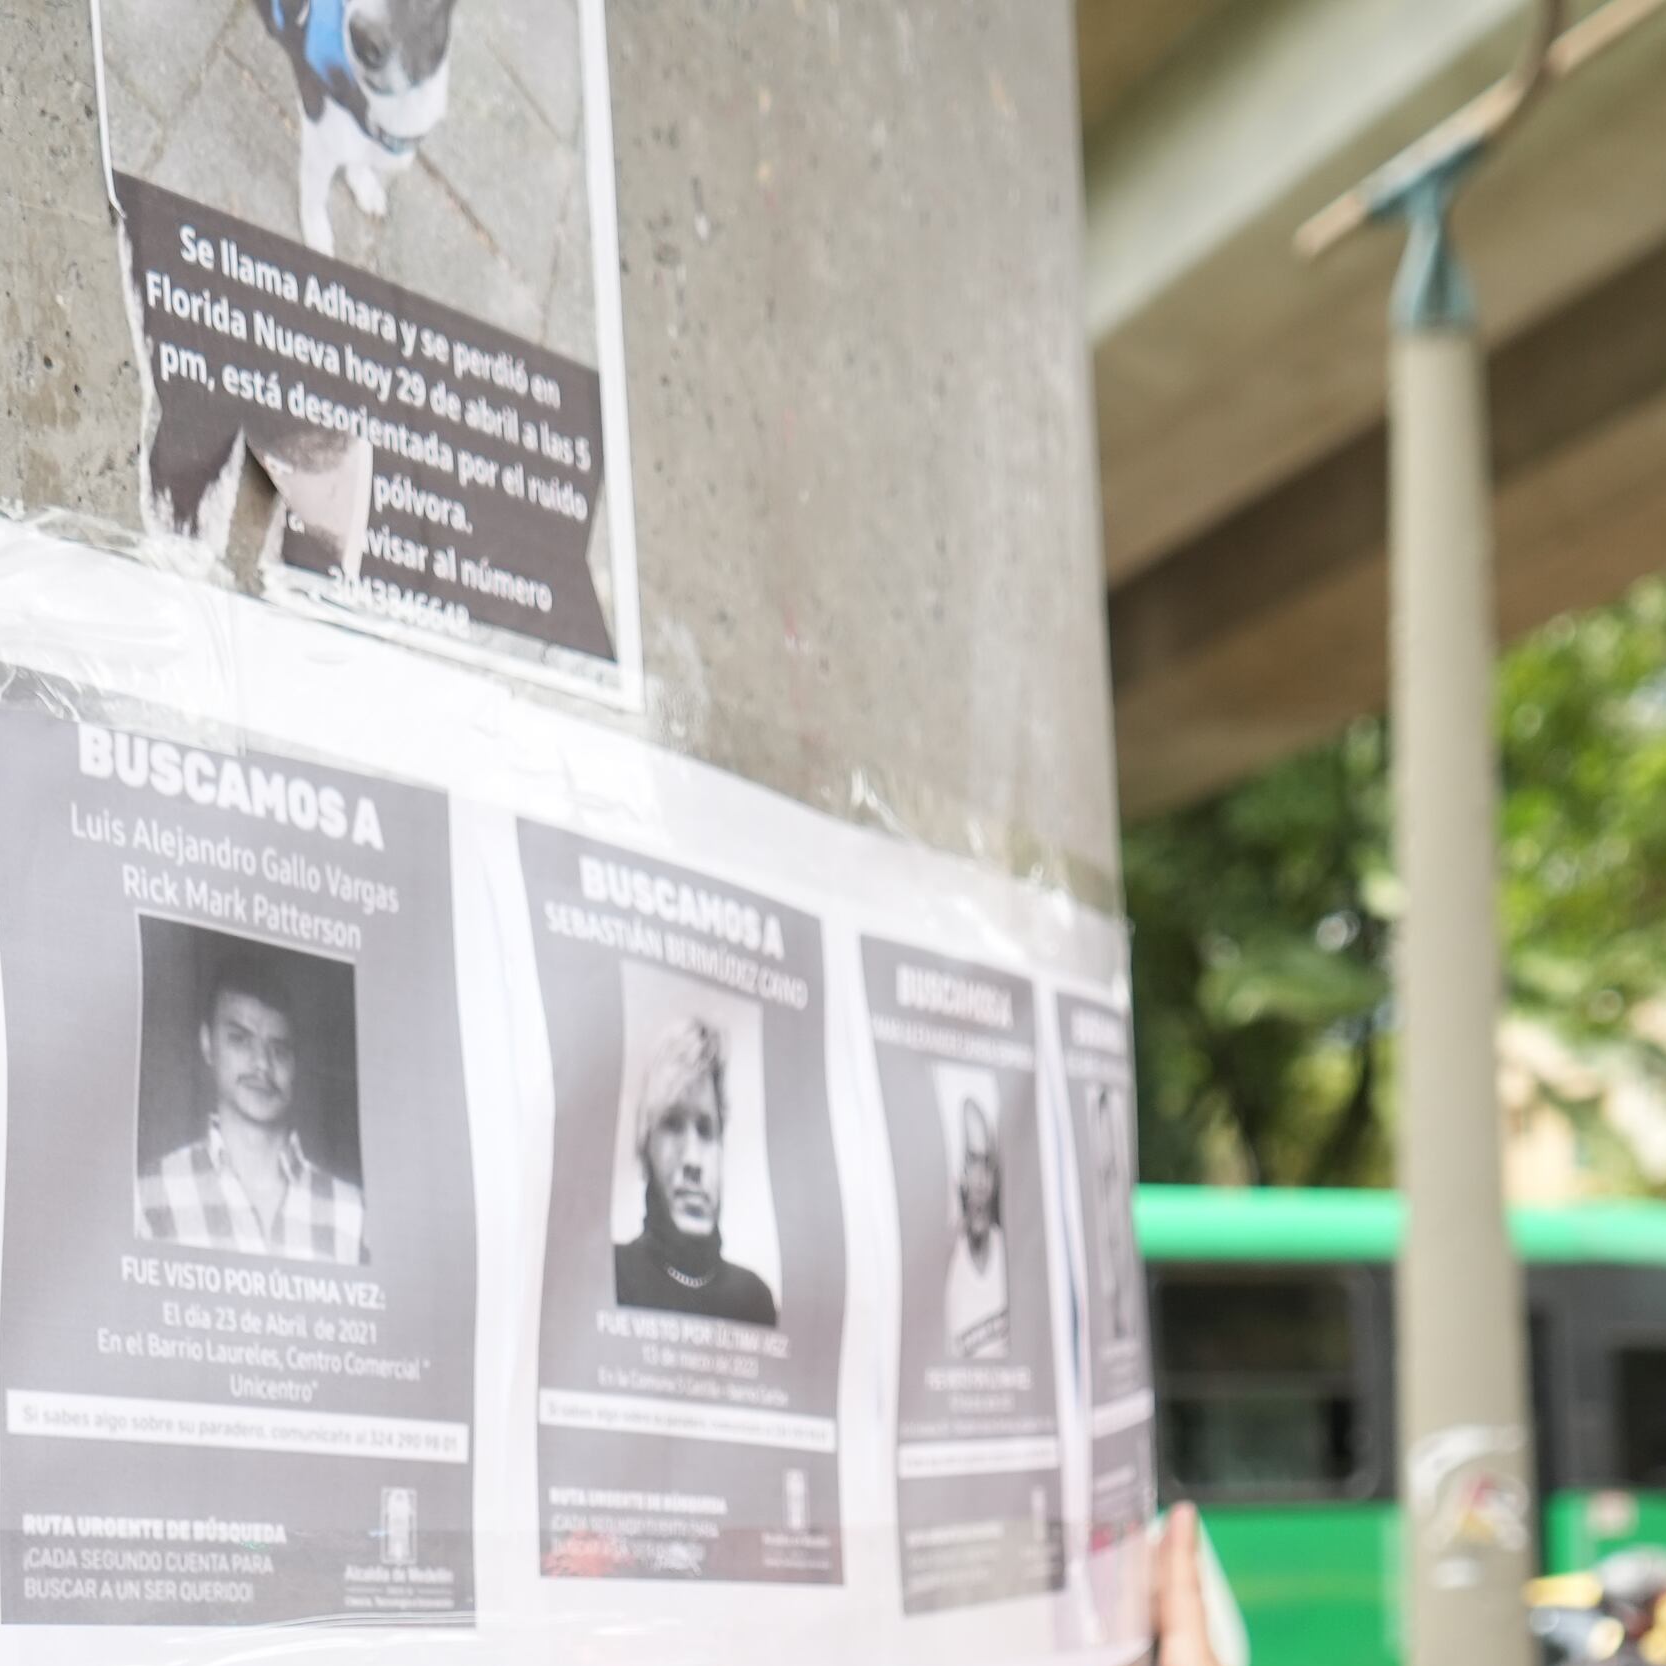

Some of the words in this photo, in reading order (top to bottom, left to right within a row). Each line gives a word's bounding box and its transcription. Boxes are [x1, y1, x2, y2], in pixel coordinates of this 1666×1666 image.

[179, 224, 215, 271] Se
[219, 237, 299, 303] llama
[304, 273, 398, 344] Adhara
[399, 318, 417, 359] y
[420, 327, 450, 366] se
[453, 339, 529, 396] perdió
[530, 372, 561, 410] en
[145, 270, 248, 342] Florida
[253, 309, 340, 377] Nueva
[344, 343, 393, 403] hoy
[395, 365, 427, 409] 29
[430, 379, 462, 423] de
[464, 395, 520, 445] abril
[522, 420, 539, 452] a
[539, 419, 575, 468] las
[575, 436, 592, 473] 5
[159, 340, 216, 392] pm,
[222, 362, 283, 411] está
[287, 379, 455, 473] desorientada
[457, 448, 500, 488] por
[501, 461, 526, 499] el
[526, 475, 589, 523] ruido
[433, 545, 457, 583] al
[459, 555, 553, 614] número
[78, 722, 347, 840] BUSCAMOS
[352, 797, 385, 852] A
[71, 801, 127, 848] Luis
[132, 816, 257, 877] Alejandro
[261, 846, 322, 893] Gallo
[325, 867, 401, 916] Vargas
[122, 864, 178, 908] Rick
[184, 877, 247, 925] Mark
[253, 893, 362, 951] Patterson
[578, 854, 763, 951] BUSCAMOS
[762, 912, 785, 962] A
[121, 1255, 161, 1288] FUE
[163, 1260, 222, 1295] VISTO
[224, 1266, 267, 1299] POR
[269, 1268, 341, 1306] ÚLTIMA
[162, 1300, 181, 1327] El
[214, 1305, 236, 1333] 23
[240, 1308, 263, 1336] de
[266, 1311, 308, 1339] Abril
[314, 1316, 336, 1343] de
[337, 1318, 378, 1345] 2021
[97, 1326, 122, 1354] En
[126, 1329, 143, 1356] el
[147, 1332, 202, 1363] Barrio
[206, 1338, 284, 1373] Laureles,
[285, 1345, 342, 1375] Centro
[343, 1351, 422, 1383] Comercial
[23, 1513, 75, 1537] RUTA
